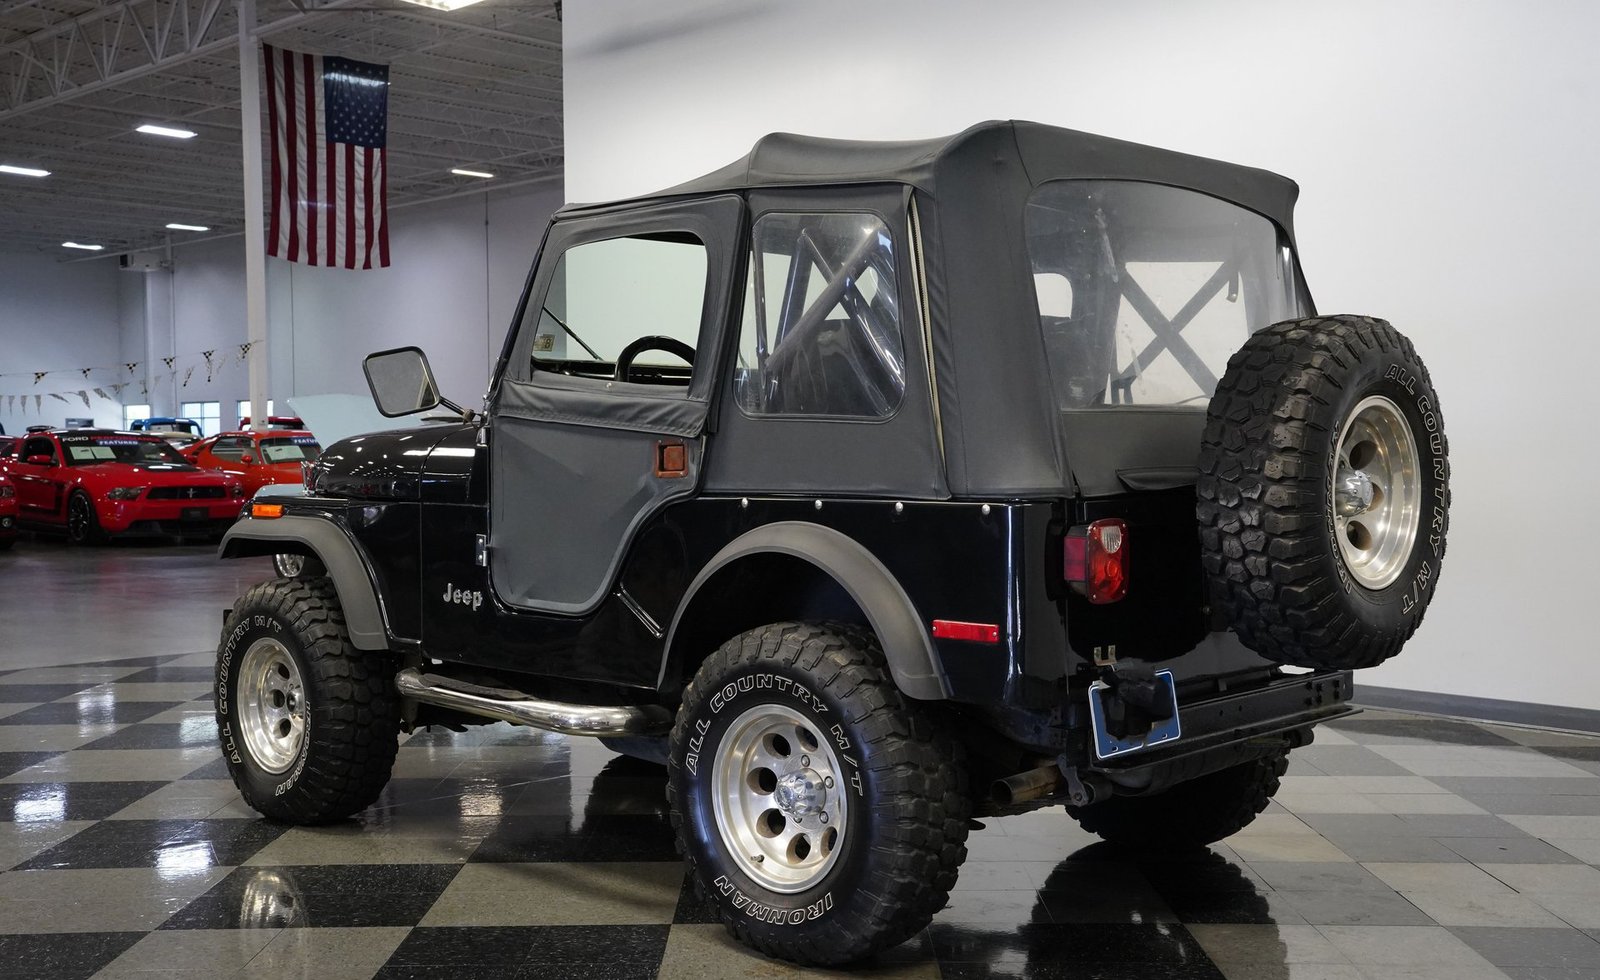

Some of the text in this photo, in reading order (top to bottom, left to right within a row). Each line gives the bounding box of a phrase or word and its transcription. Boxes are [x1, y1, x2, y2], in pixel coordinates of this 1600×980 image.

[1385, 363, 1445, 614] ALL COUNTRY M/T
[442, 582, 483, 612] Jeep
[219, 615, 282, 764] ALL COUNTRY M/T
[685, 674, 864, 798] ALL COUNTRY M/T
[714, 875, 834, 925] IRONMAN
